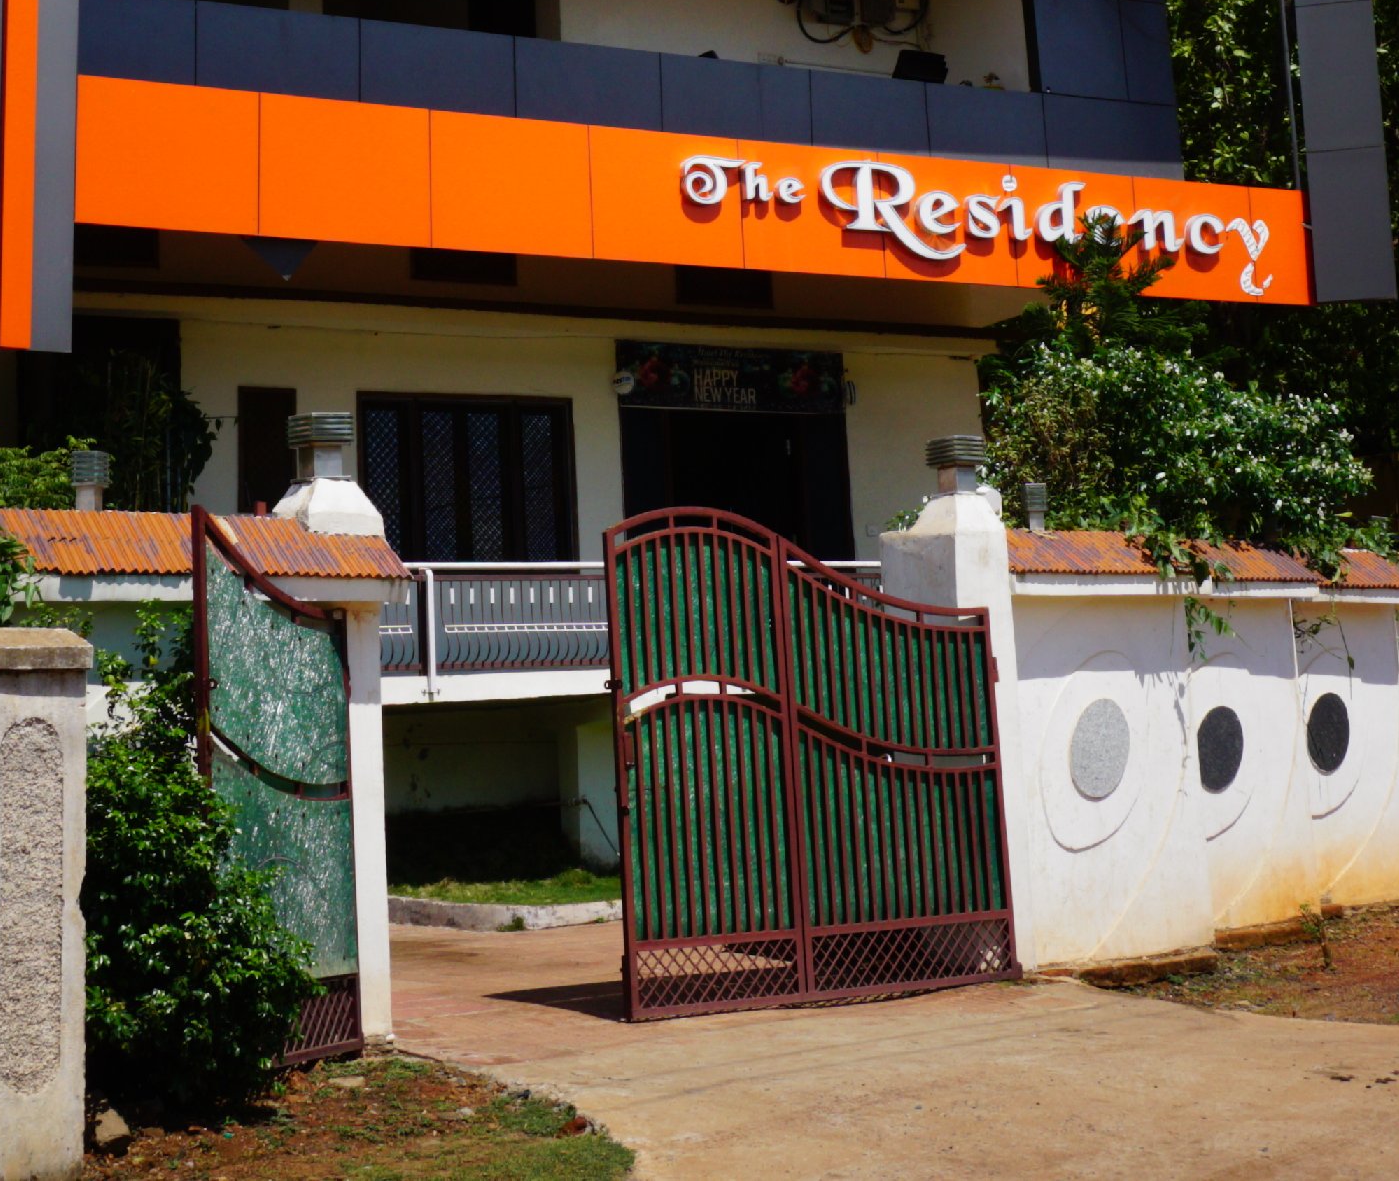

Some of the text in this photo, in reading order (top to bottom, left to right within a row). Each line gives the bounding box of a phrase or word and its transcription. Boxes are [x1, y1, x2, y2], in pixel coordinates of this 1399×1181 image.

[681, 155, 806, 204] The
[693, 368, 738, 387] HAPPY
[694, 386, 756, 404] NEW YEAR
